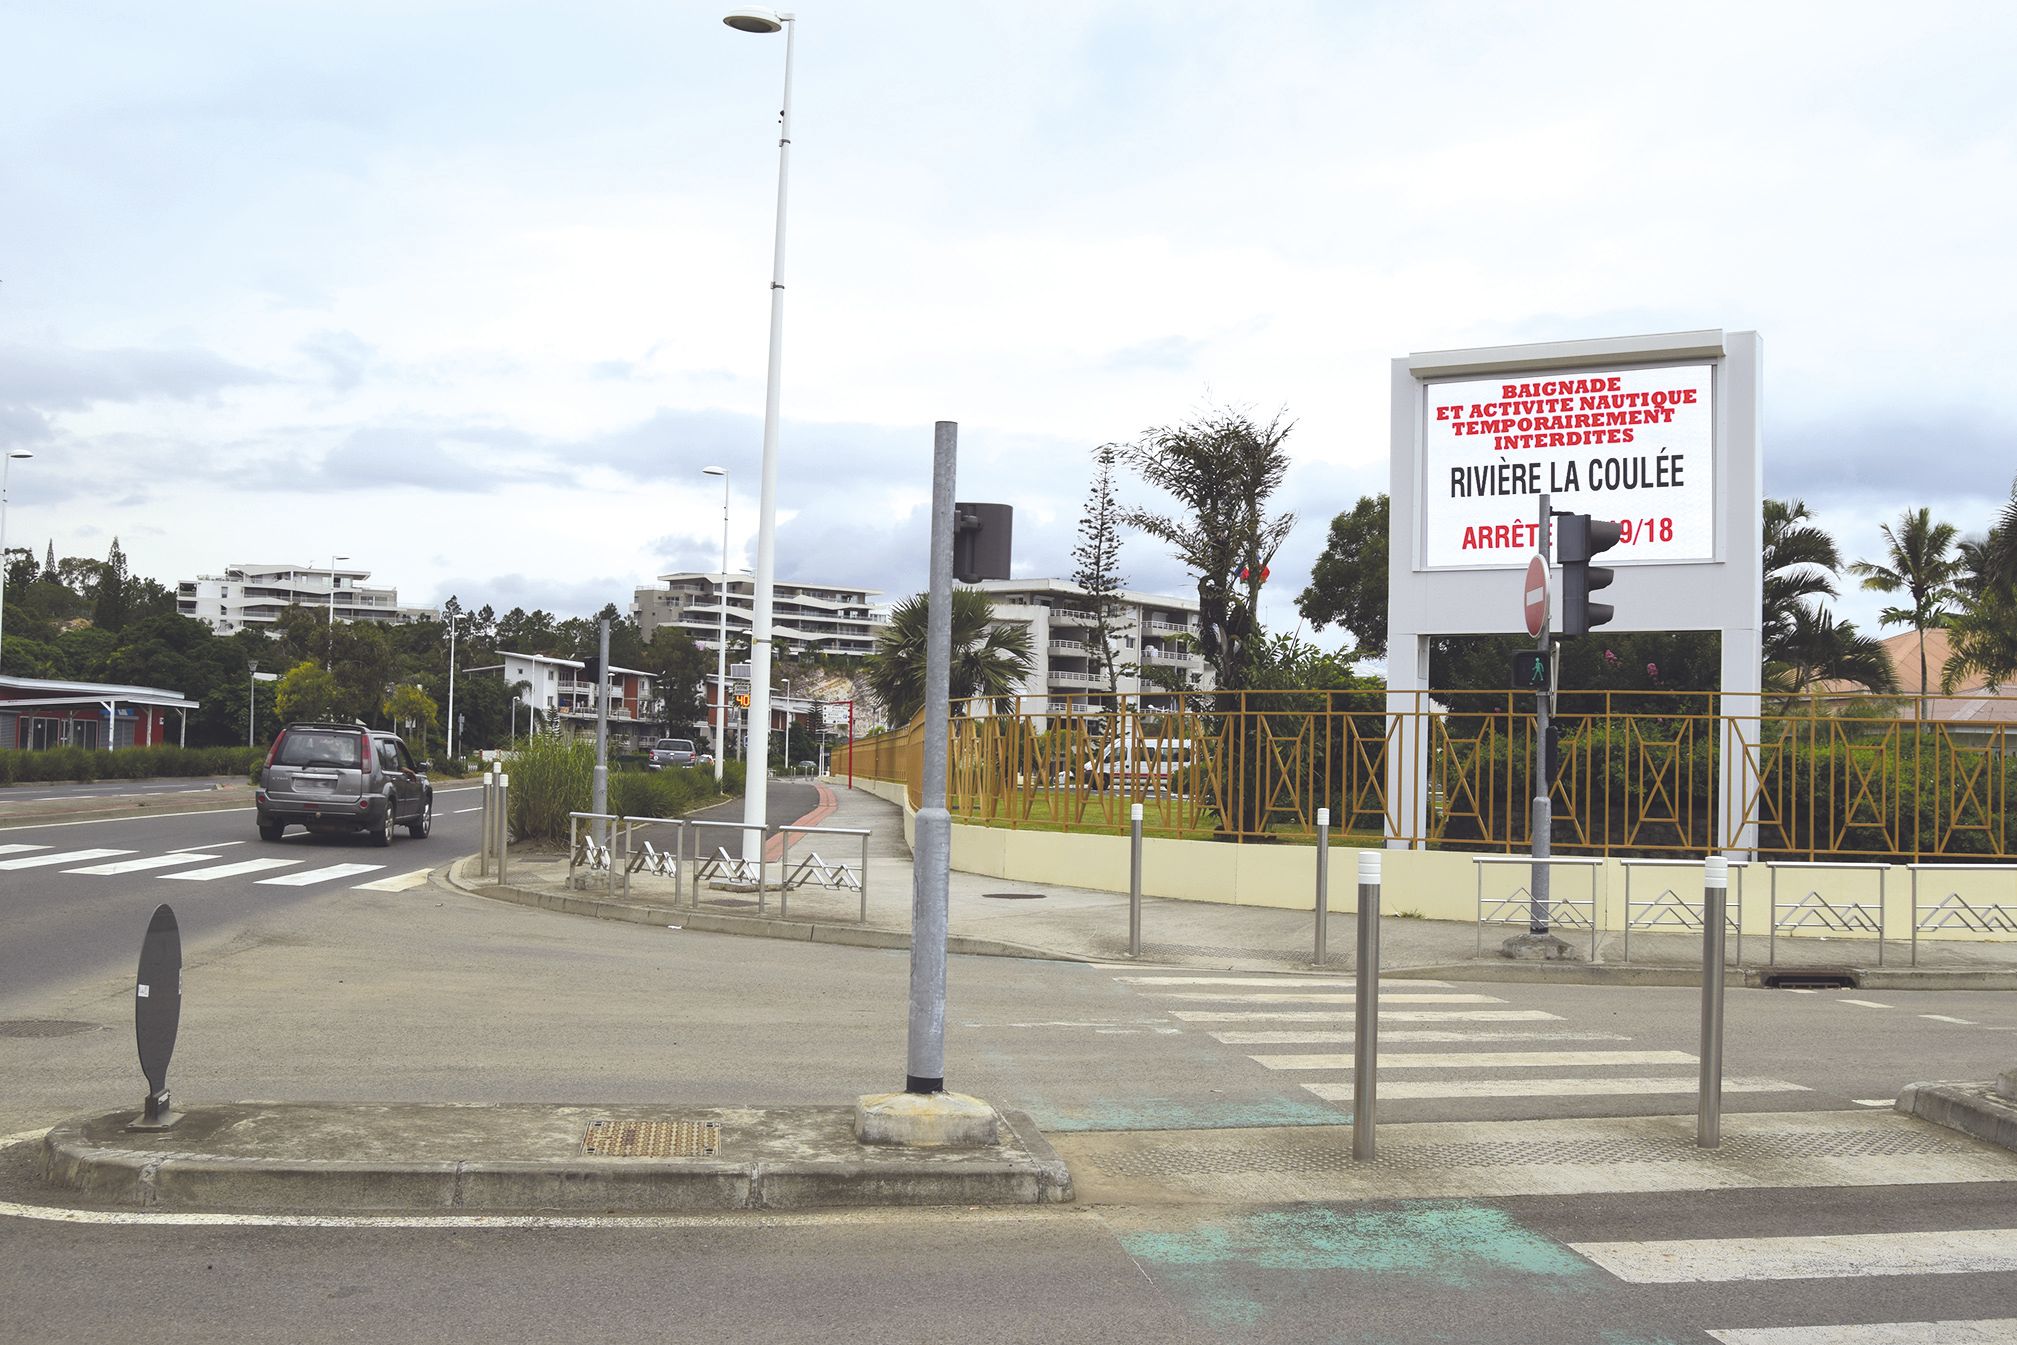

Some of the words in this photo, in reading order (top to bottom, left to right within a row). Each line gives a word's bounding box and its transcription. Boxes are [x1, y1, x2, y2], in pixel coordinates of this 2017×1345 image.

[1502, 377, 1621, 399] BAIGNADE
[1437, 405, 1465, 421] ET
[1469, 397, 1574, 419] ACTIVITE
[1580, 389, 1697, 411] NAUTIQUE
[1452, 407, 1675, 437] TEMPORAIREMENT
[1494, 428, 1634, 451] INTERDITES
[1451, 457, 1542, 498] RIVIÈRE
[1550, 460, 1580, 493] LA
[1588, 446, 1684, 492] COULÉE
[736, 694, 750, 706] 40
